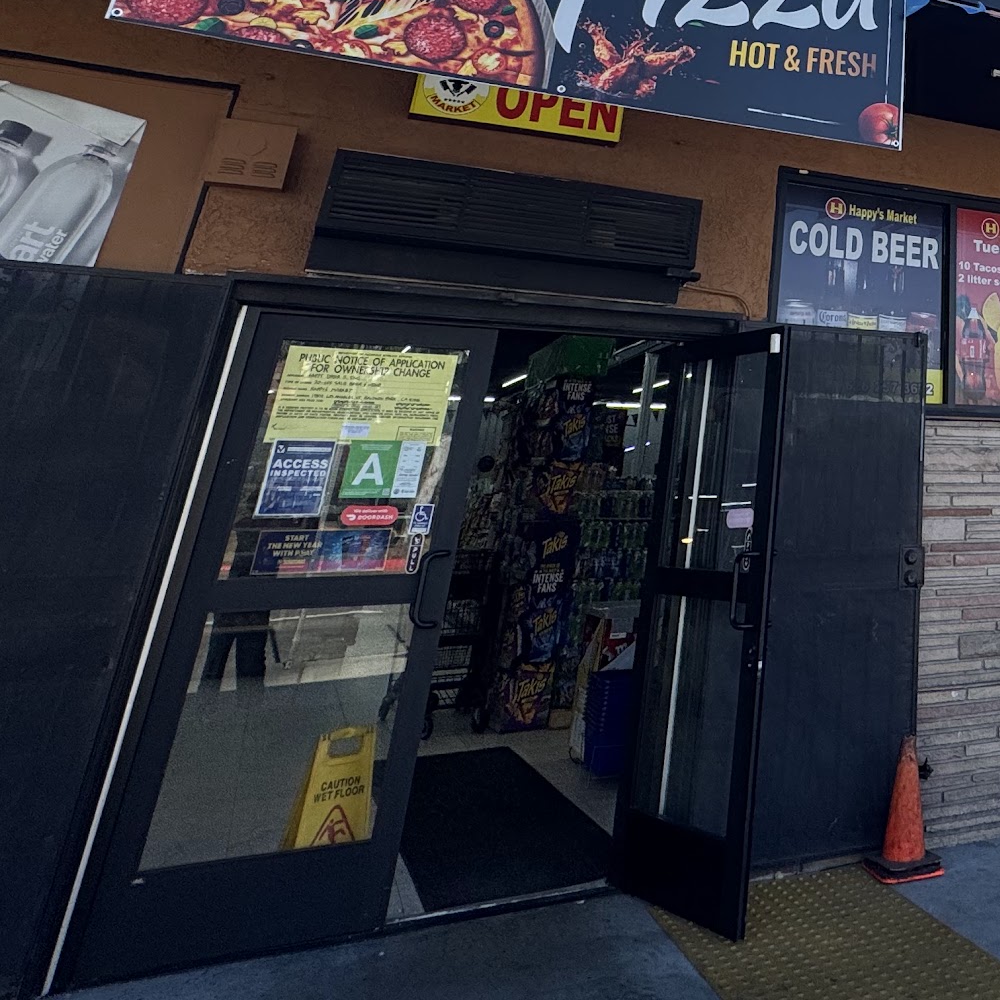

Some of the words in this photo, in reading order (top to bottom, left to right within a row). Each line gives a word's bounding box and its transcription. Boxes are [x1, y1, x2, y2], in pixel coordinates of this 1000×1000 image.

[729, 39, 780, 70] HOT
[784, 45, 799, 72] &
[806, 46, 877, 79] FRESH
[430, 93, 478, 113] MARKET
[495, 87, 618, 133] OPEN
[849, 203, 884, 222] Happy's
[886, 209, 917, 225] Market
[789, 220, 864, 260] COLD
[871, 230, 939, 270] BEER
[958, 260, 971, 271] 10
[958, 273, 965, 283] 2
[967, 274, 991, 286] litter
[299, 353, 331, 364] PUBLIC
[335, 355, 369, 366] NOTICE
[373, 357, 385, 366] OF
[389, 358, 446, 370] APPLICATION
[310, 363, 330, 373] FOR
[393, 367, 431, 378] CHANGE
[562, 382, 592, 393] INTENSE
[566, 391, 585, 401] FANS
[563, 415, 586, 438] Takis
[271, 458, 328, 469] ACCESS
[351, 453, 384, 486] A
[269, 469, 327, 477] INSPECTED
[550, 472, 578, 494] Takis
[267, 542, 282, 550] THE
[302, 541, 322, 549] YEAR
[284, 534, 309, 542] START
[542, 533, 569, 560] Takis
[408, 546, 419, 572] PULL
[532, 571, 565, 585] INTENSE
[537, 583, 557, 594] FANS
[516, 675, 547, 702] Takis
[321, 775, 361, 792] CAUTION
[313, 790, 333, 804] WET
[333, 784, 365, 800] FLOOR
